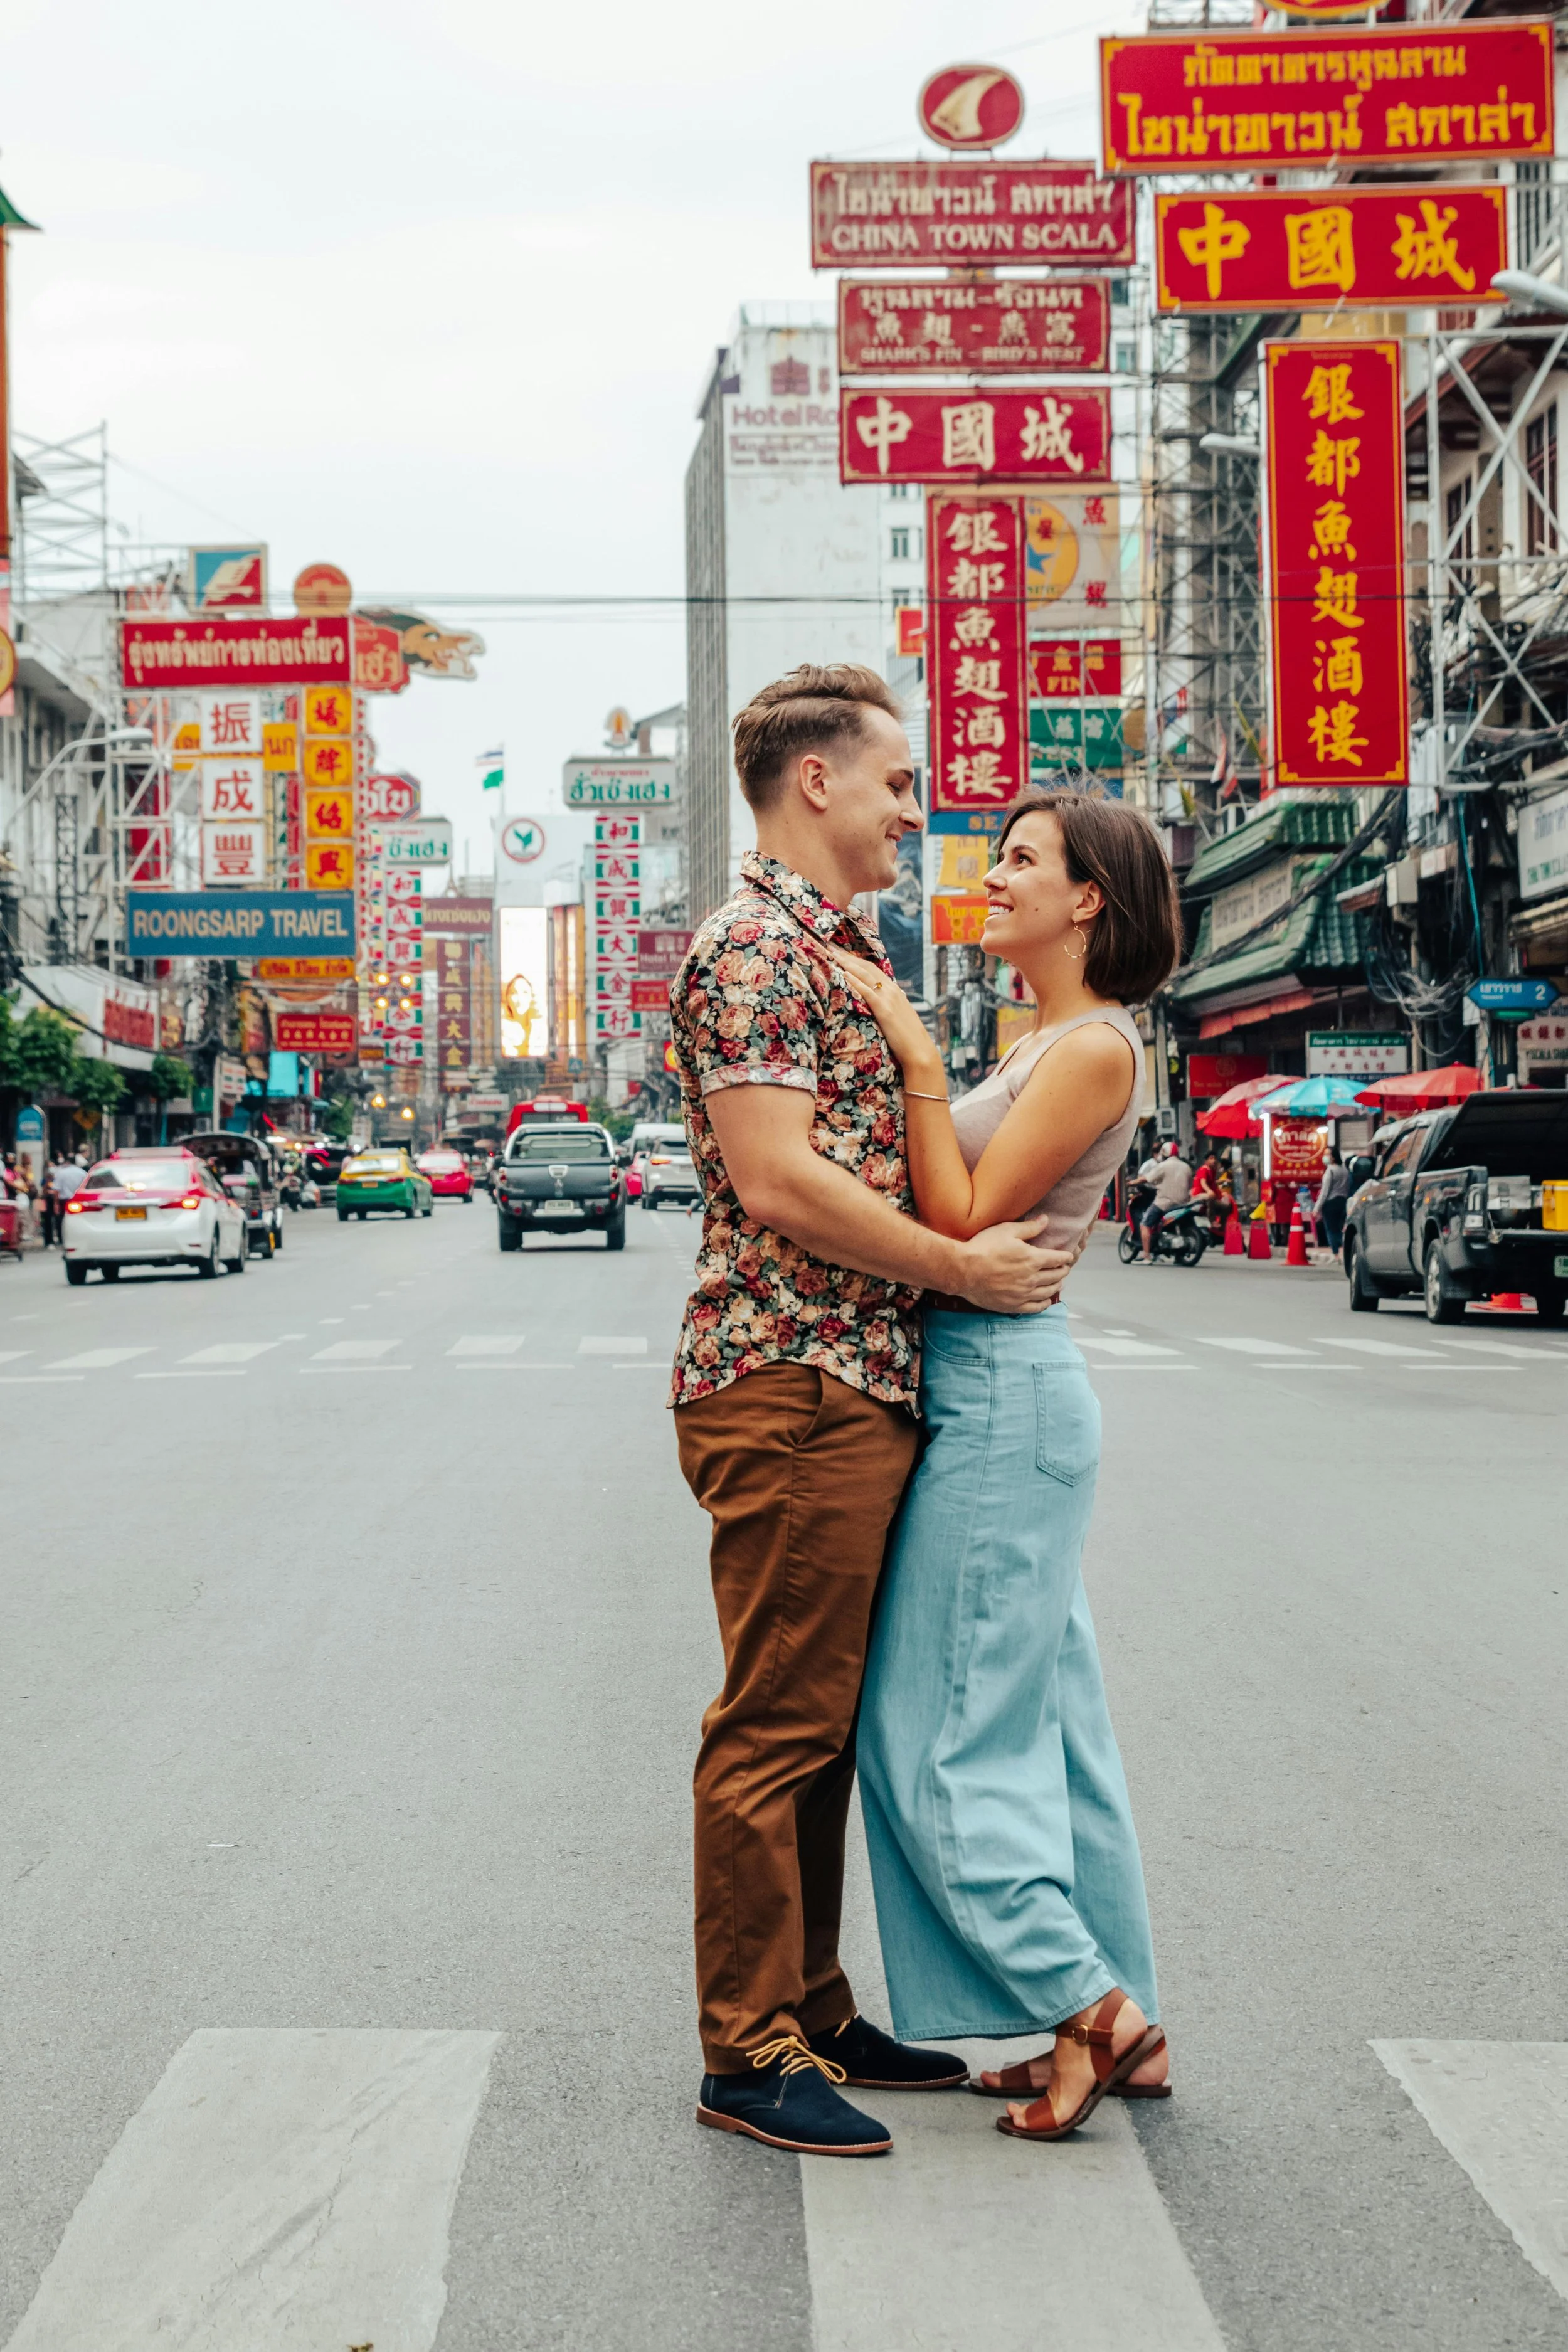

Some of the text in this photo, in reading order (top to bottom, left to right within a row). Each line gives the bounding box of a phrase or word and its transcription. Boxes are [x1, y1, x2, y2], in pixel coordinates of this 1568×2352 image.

[1117, 85, 1537, 157] ไชน่าทาวน์ สกาล่า
[831, 223, 1115, 252] CHINA TOWN SCALA
[1177, 199, 1476, 300] 中國城
[936, 346, 963, 363] FIN
[982, 346, 1037, 363] BIRD'S
[1041, 346, 1085, 363] NEST
[733, 405, 802, 426] Hotel
[856, 396, 1084, 475] 中國城
[1301, 362, 1369, 767] 銀都魚翅酒樓
[945, 511, 1014, 800] 銀都魚翅酒樓
[210, 702, 254, 876] 振成豐
[133, 908, 348, 938] ROONGSARP TRAVEL
[1535, 985, 1546, 1000] 2
